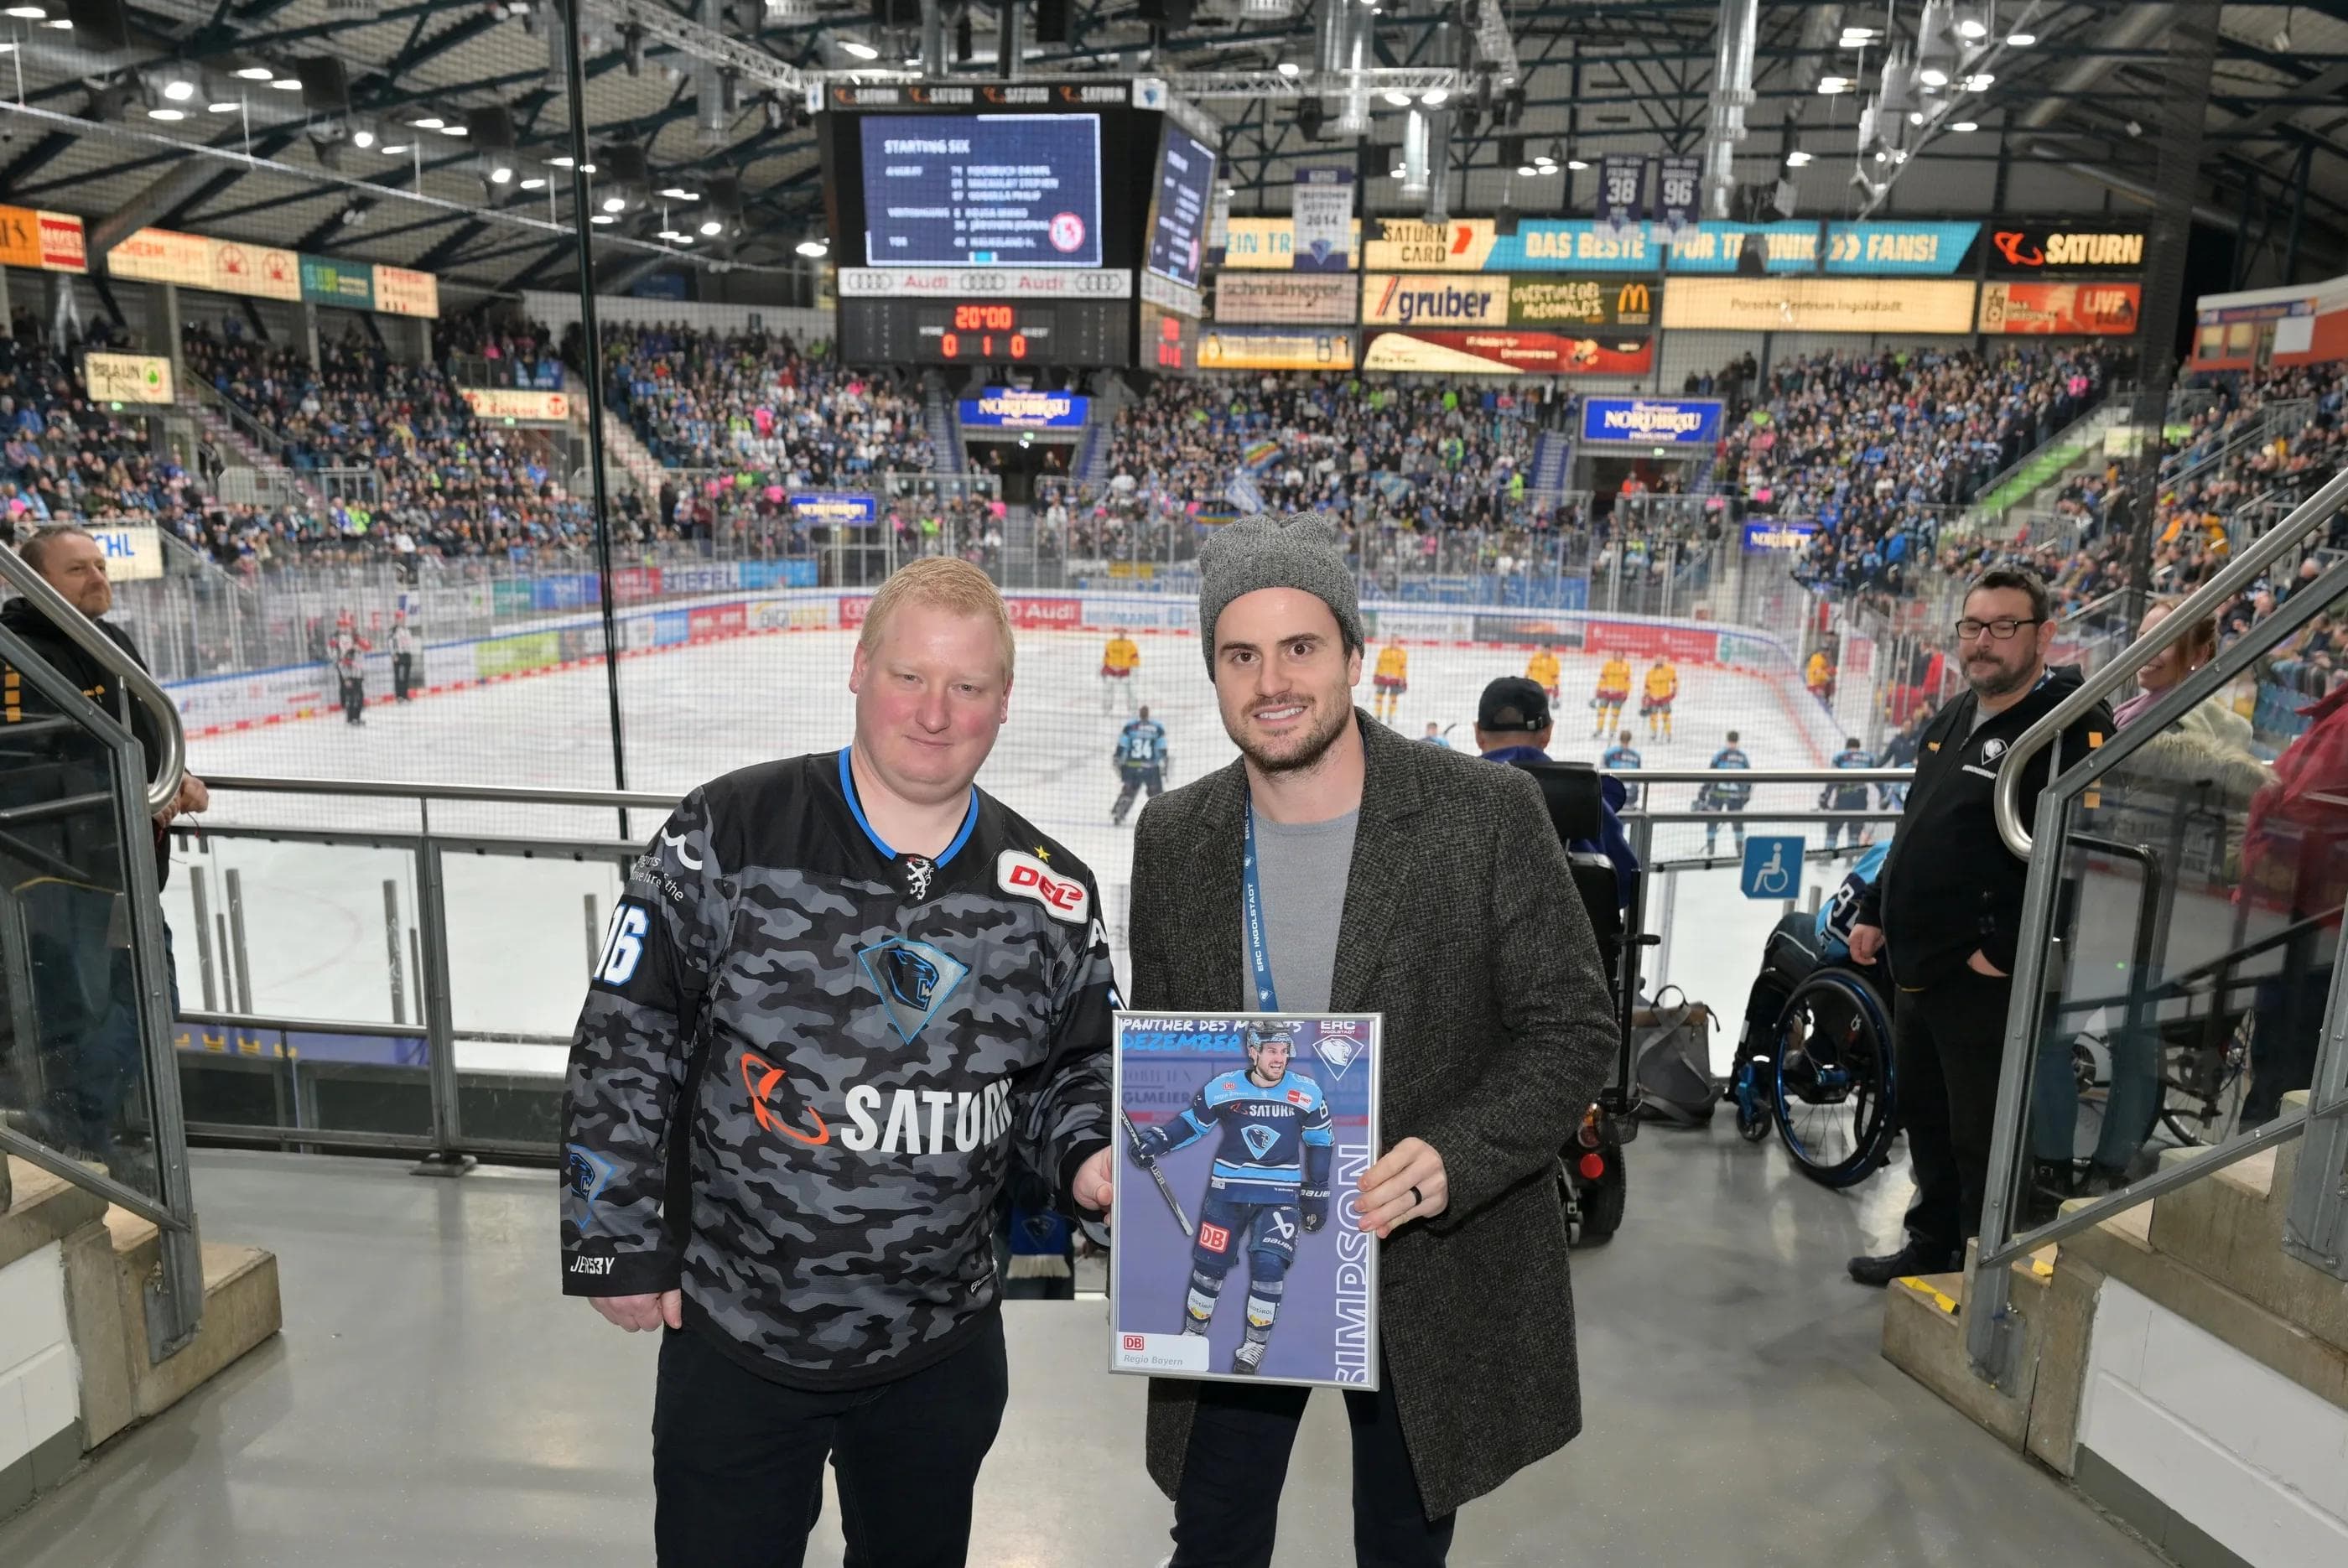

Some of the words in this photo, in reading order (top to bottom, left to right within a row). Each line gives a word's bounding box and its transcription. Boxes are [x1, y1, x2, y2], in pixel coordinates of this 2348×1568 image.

[1606, 177, 1637, 204] 38
[1663, 179, 1693, 205] 96
[1306, 214, 1339, 226] 2014
[1384, 224, 1447, 243] SATURN
[1401, 245, 1447, 262] CARD
[1525, 231, 1572, 259] DAS
[1866, 233, 1939, 262] FANS!
[2044, 233, 2144, 264] SATURN
[904, 274, 948, 288] Audi
[1019, 274, 1064, 289] Audi
[1398, 286, 1492, 324] gruber
[1024, 604, 1075, 620] Audi
[1247, 883, 1260, 948] INGOLSTADT
[1121, 1018, 1194, 1032] PANTHER
[1199, 1020, 1229, 1032] DES
[1320, 1020, 1356, 1030] ERC
[1122, 1032, 1241, 1052] DEZEMBER
[1201, 1224, 1226, 1250] DB
[1125, 1337, 1143, 1349] DB
[1124, 1354, 1149, 1365] Regio
[1151, 1355, 1183, 1366] Bayern
